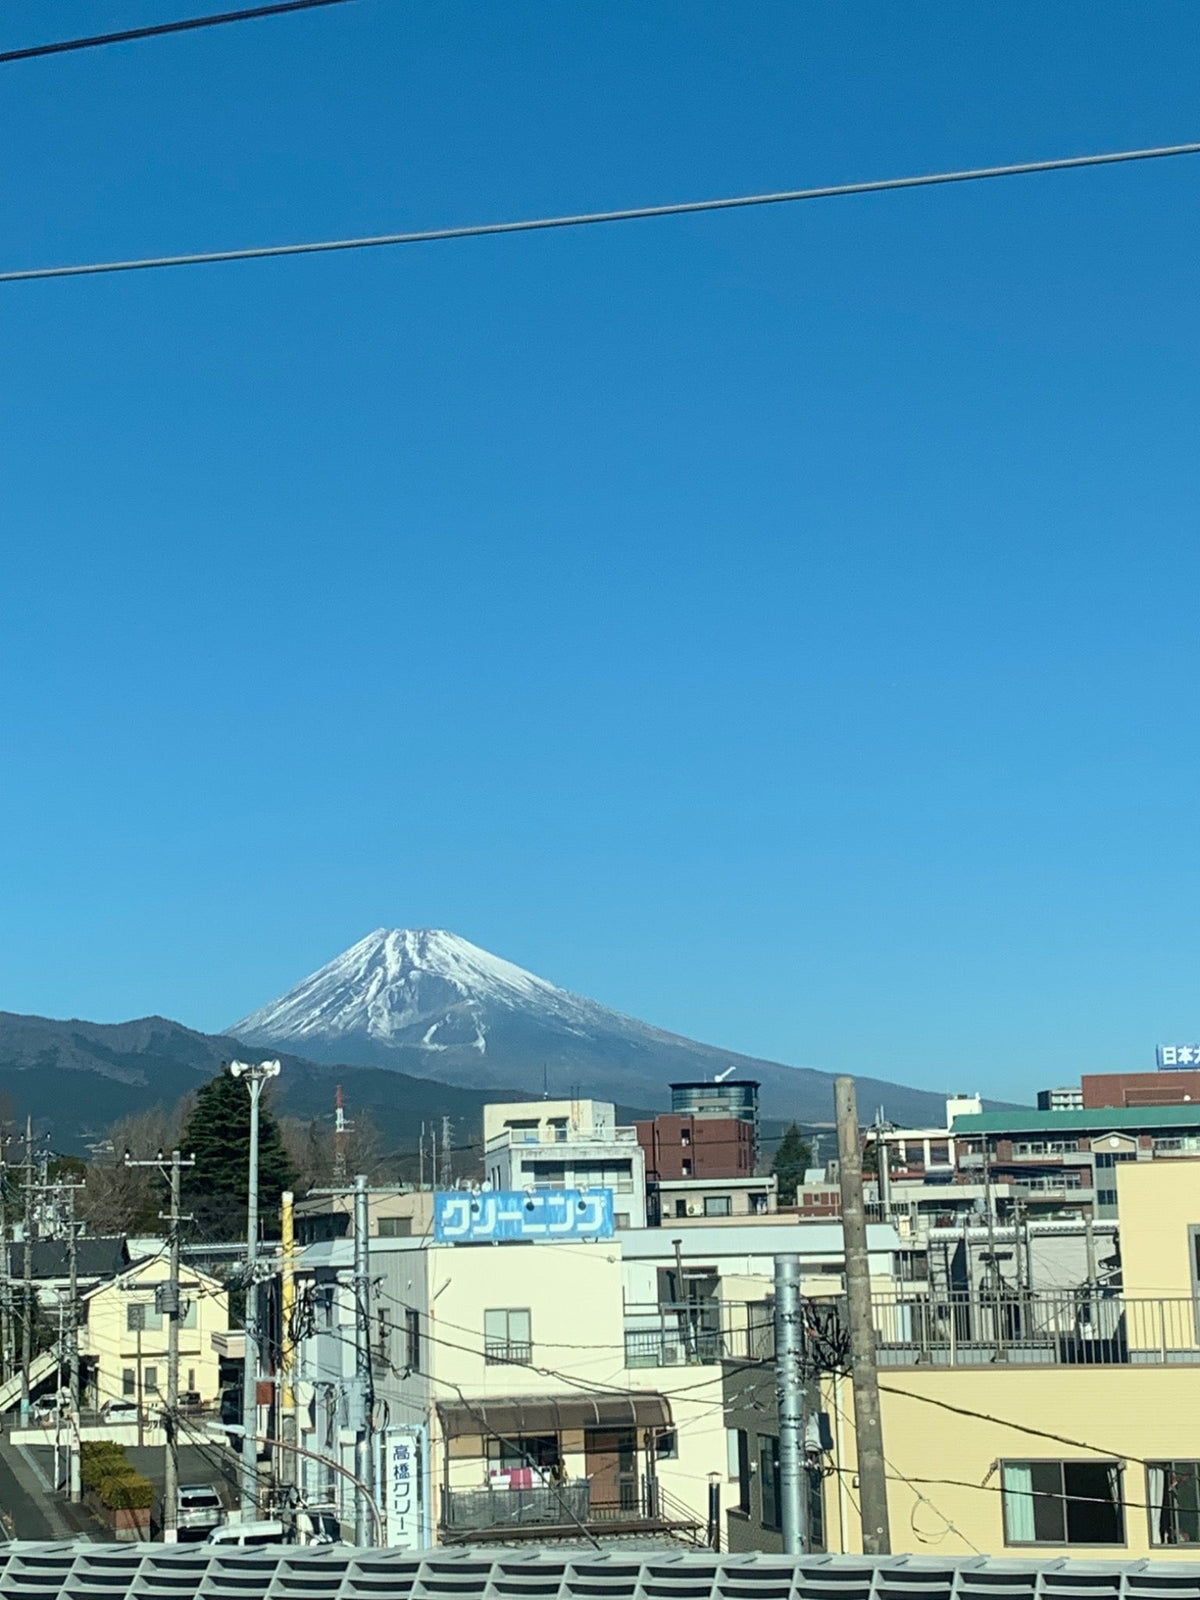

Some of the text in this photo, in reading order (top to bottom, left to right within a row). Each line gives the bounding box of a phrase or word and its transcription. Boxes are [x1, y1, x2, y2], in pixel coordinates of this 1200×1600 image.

[442, 1196, 605, 1236] クリーニング
